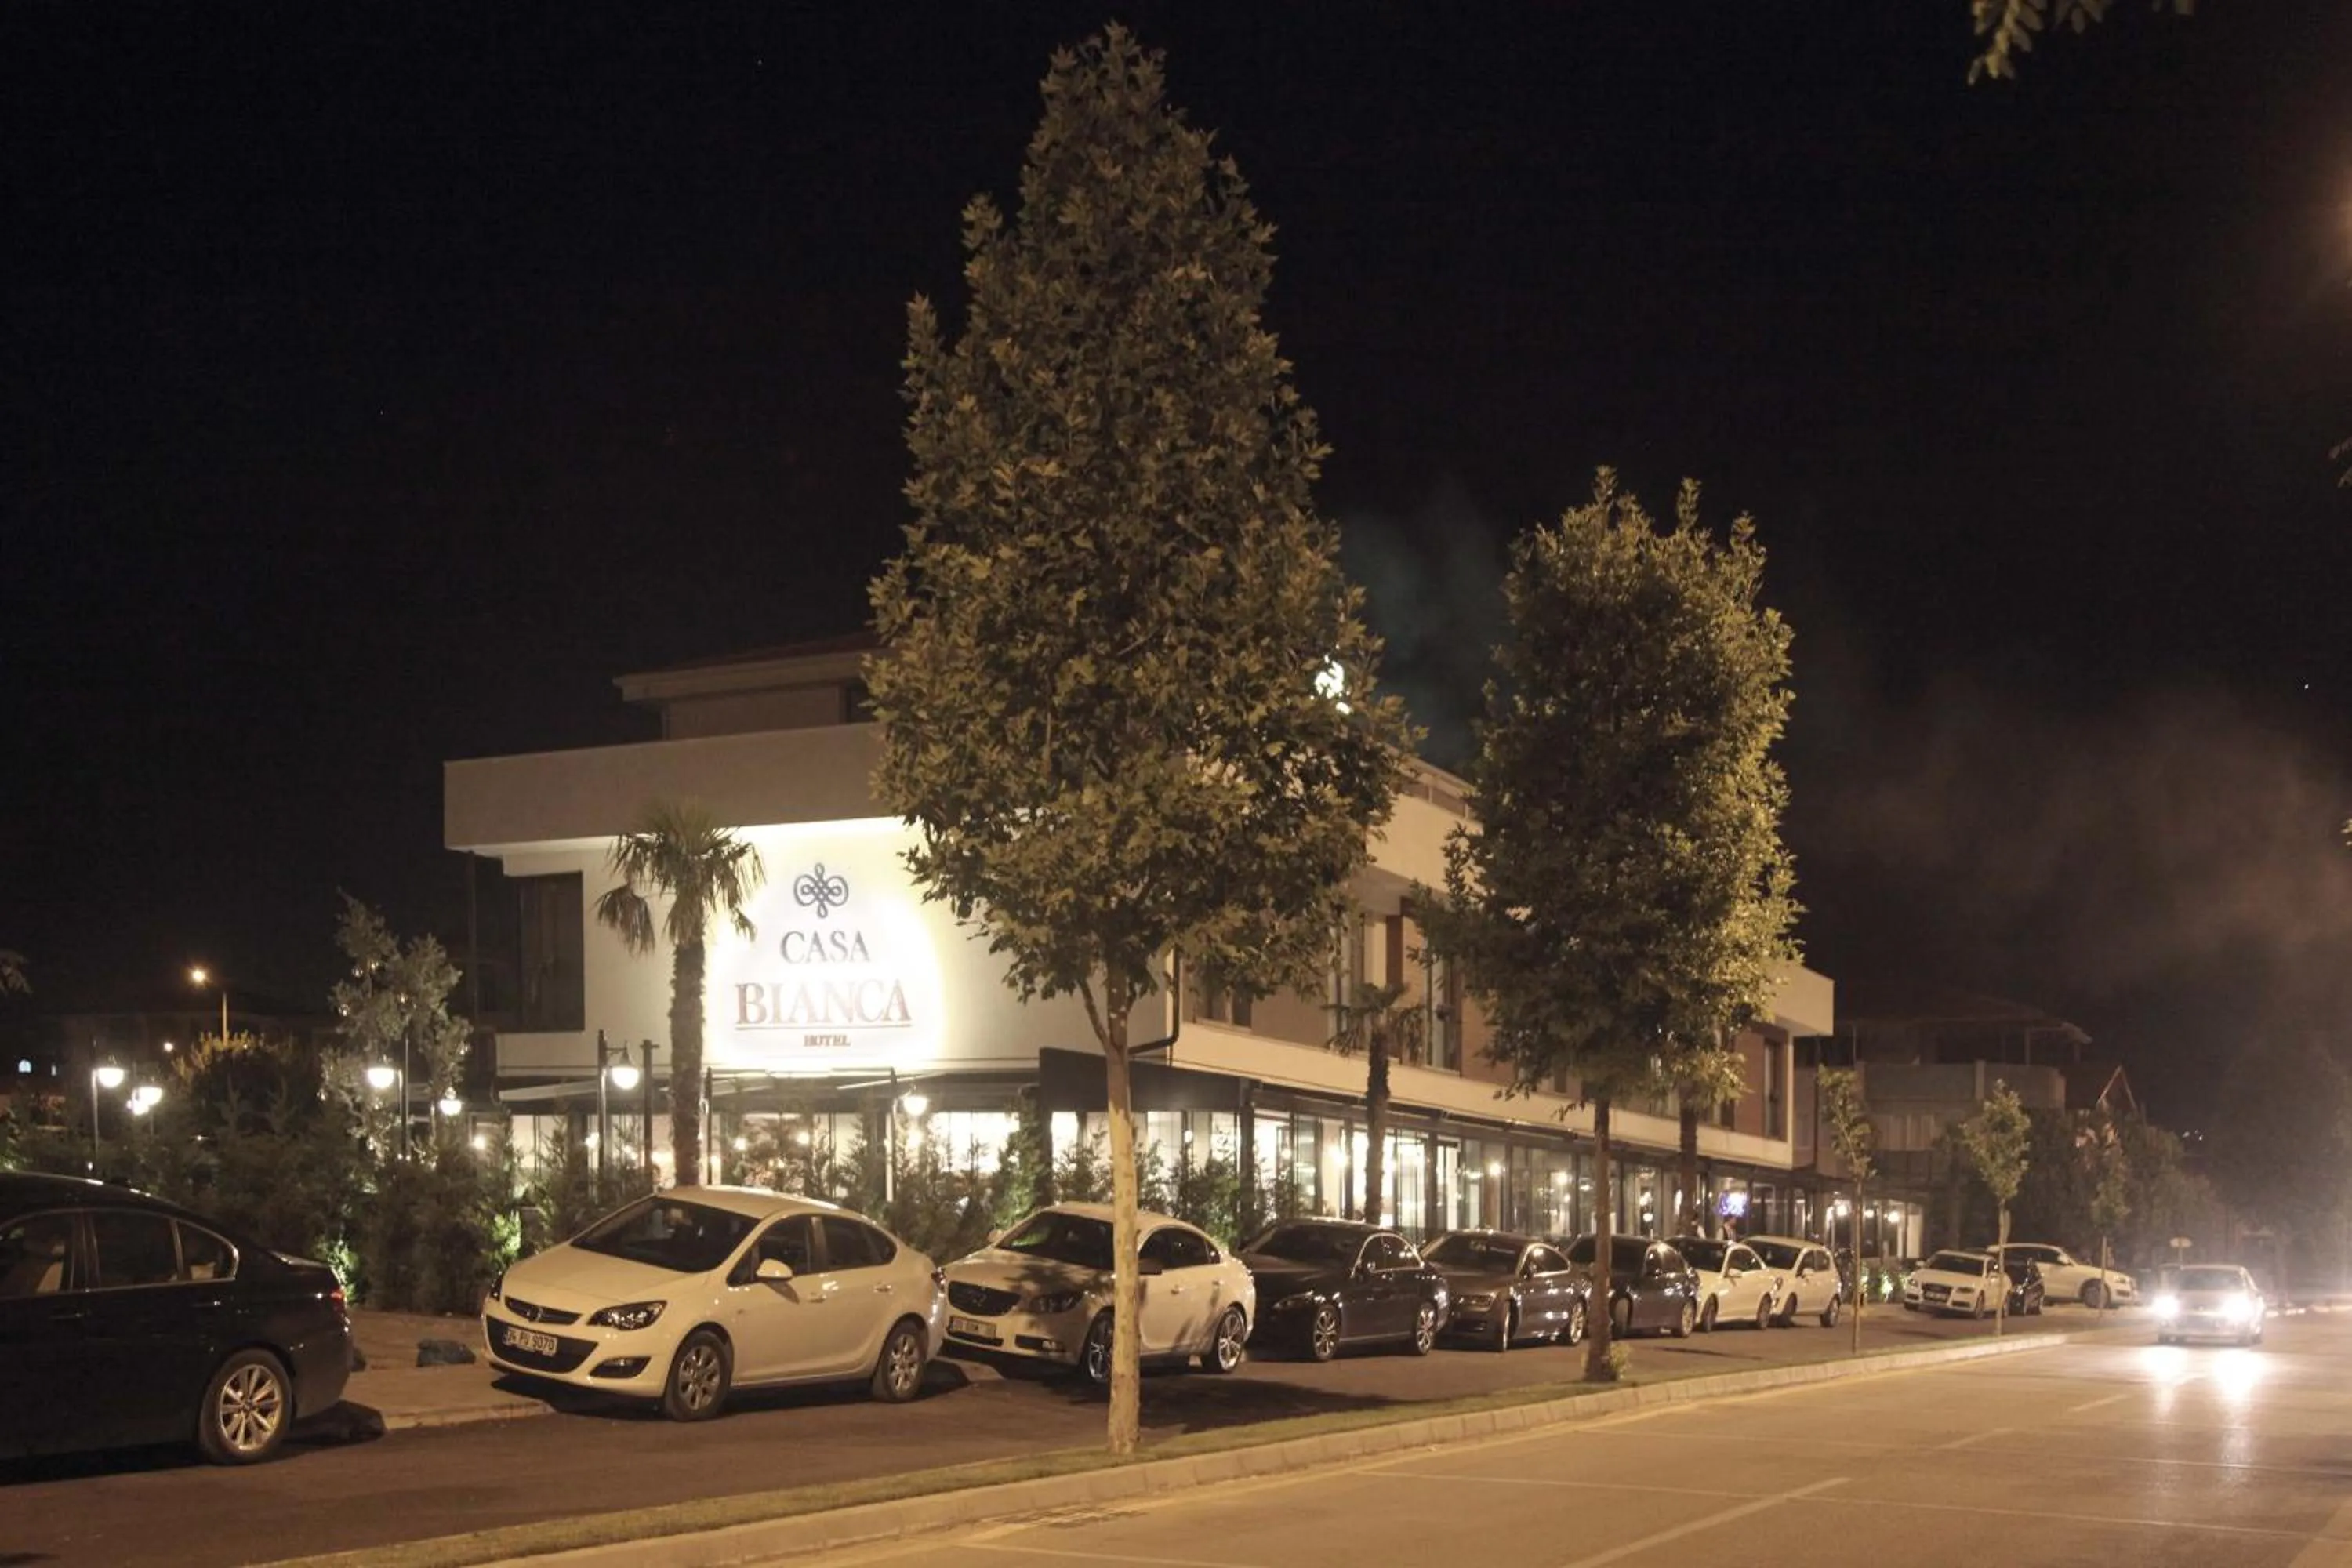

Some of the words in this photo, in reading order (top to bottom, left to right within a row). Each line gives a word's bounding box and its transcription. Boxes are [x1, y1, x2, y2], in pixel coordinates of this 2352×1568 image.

[780, 930, 870, 964] CASA
[735, 979, 911, 1024] BIANCA
[804, 1035, 851, 1047] HOTEL
